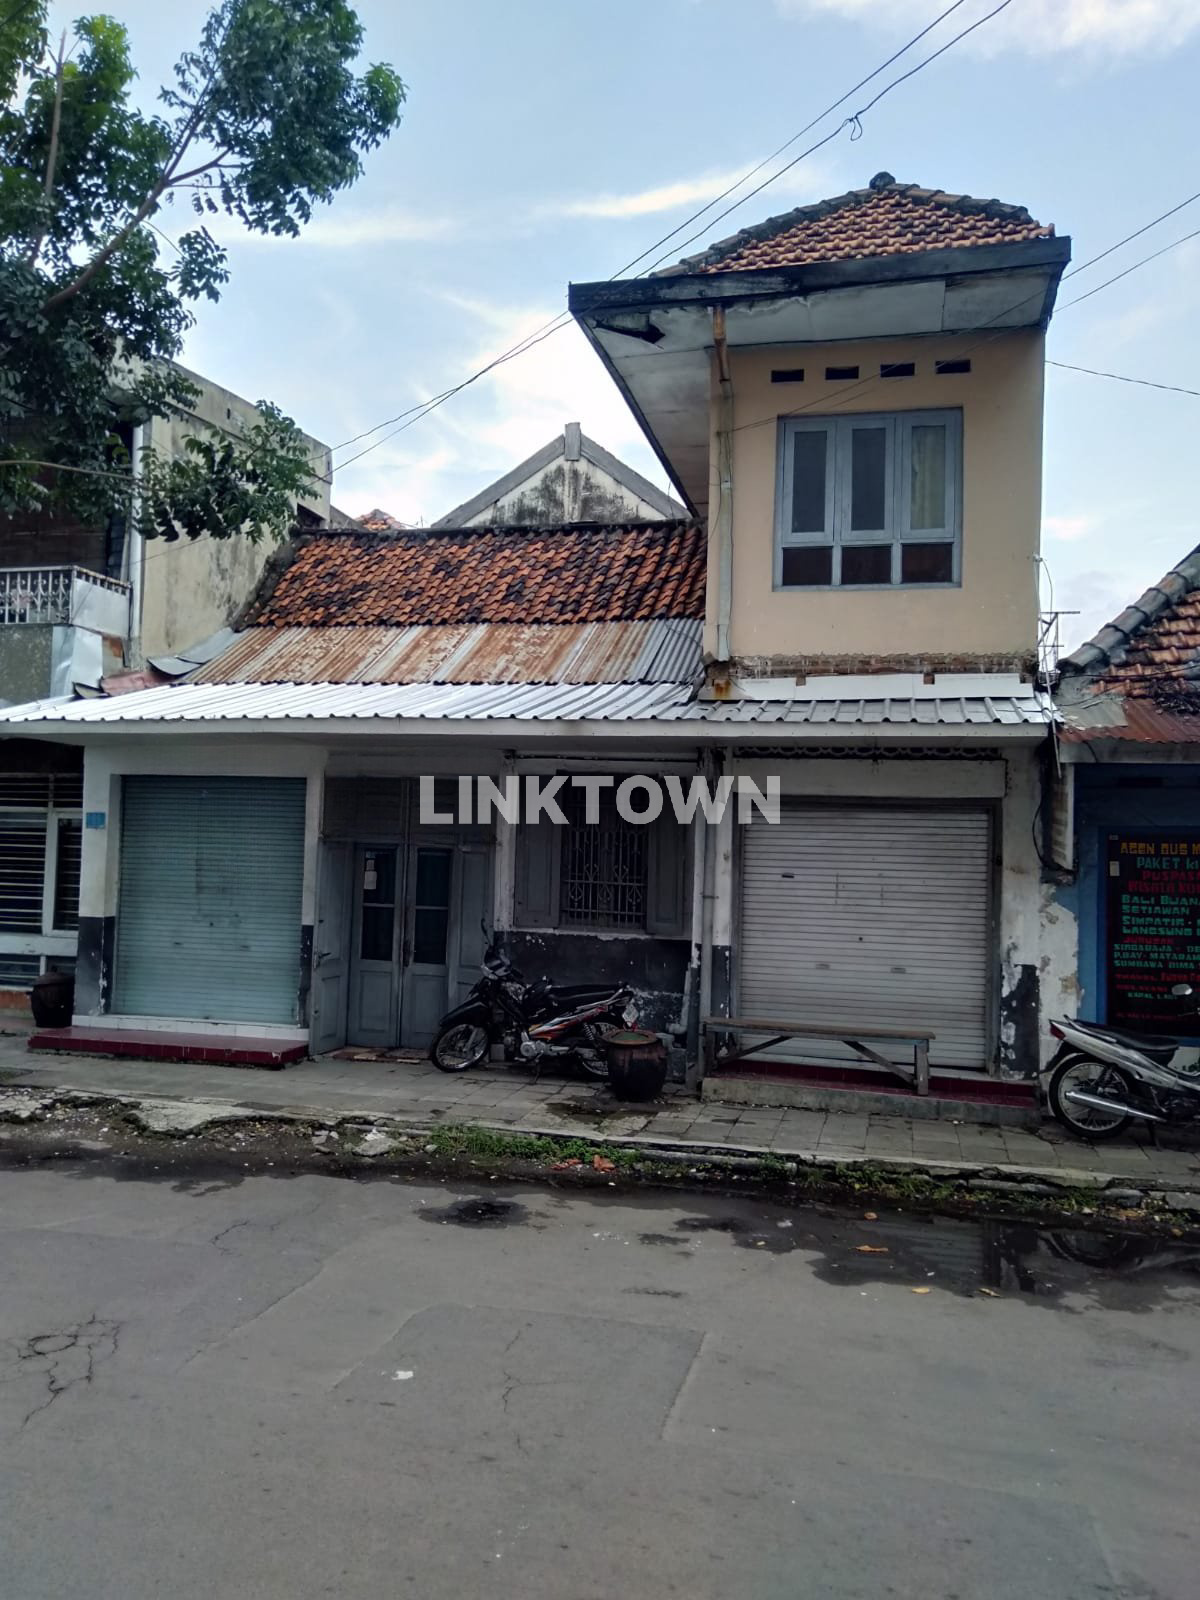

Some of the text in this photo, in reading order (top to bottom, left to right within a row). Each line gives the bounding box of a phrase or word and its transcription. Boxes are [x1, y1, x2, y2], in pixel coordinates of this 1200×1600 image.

[1120, 842, 1155, 854] AGEN
[1160, 843, 1188, 855] BUS
[1136, 856, 1181, 869] PAKET
[1121, 894, 1155, 904] BALI
[1121, 904, 1190, 915] SETIAWAN
[1121, 926, 1193, 937] LANGSUNG
